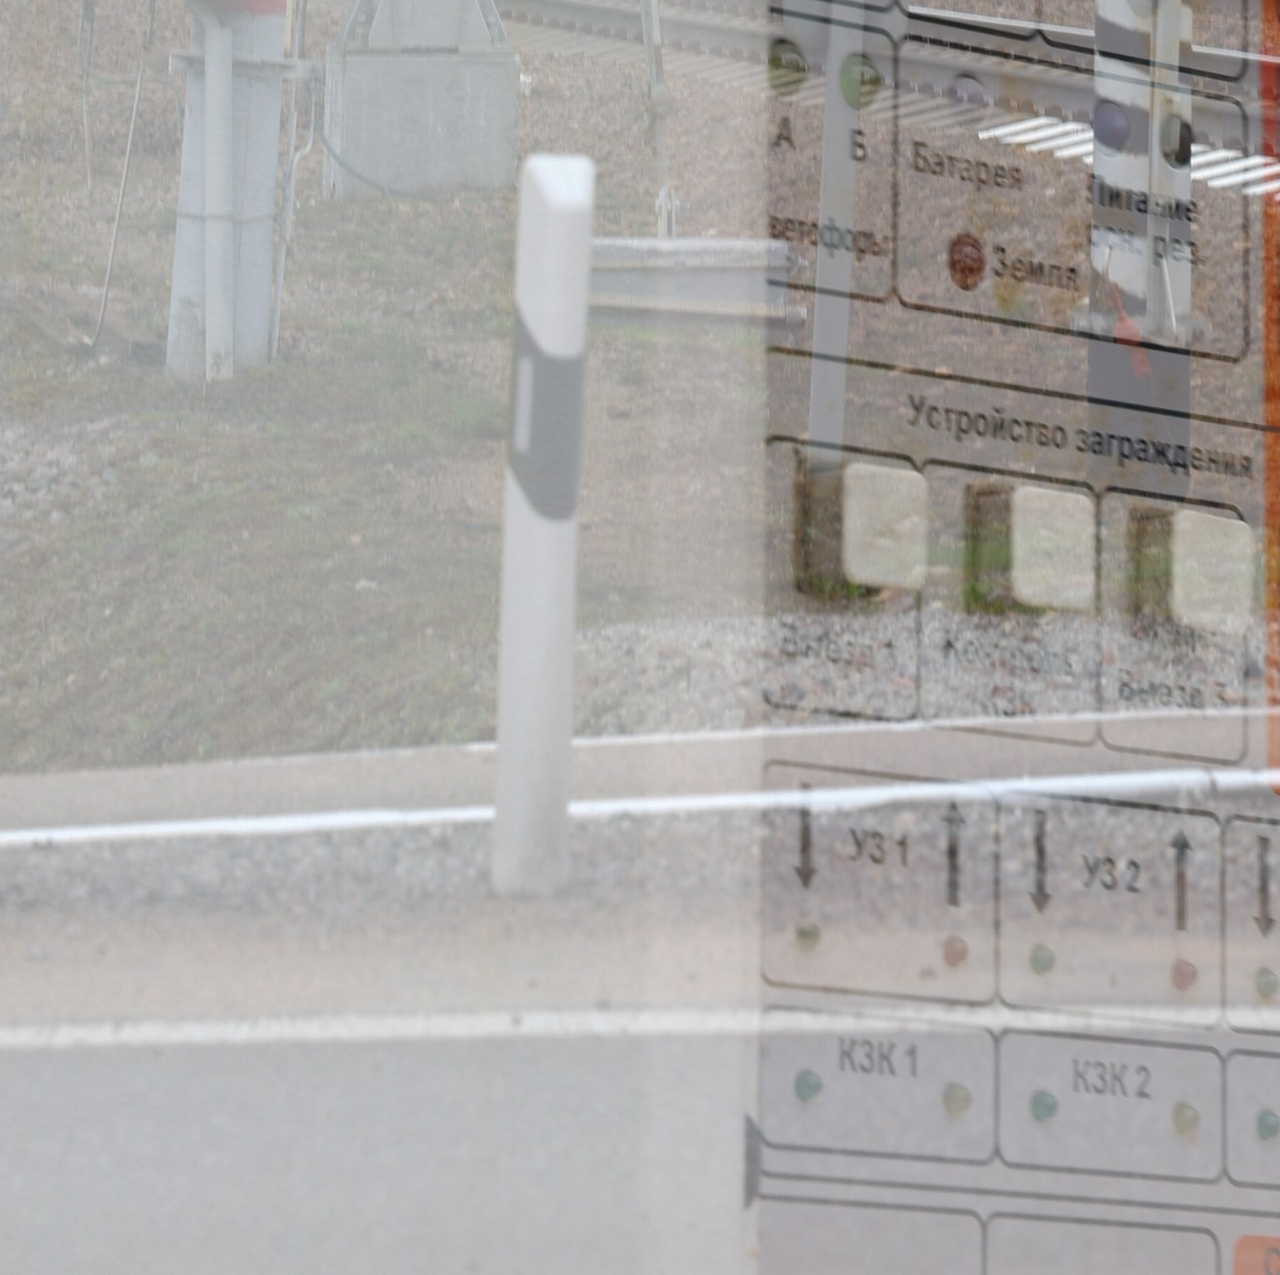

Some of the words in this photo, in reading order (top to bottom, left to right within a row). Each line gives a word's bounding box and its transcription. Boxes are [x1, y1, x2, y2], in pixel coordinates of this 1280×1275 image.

[773, 117, 795, 151] А
[850, 129, 867, 161] Б
[914, 141, 1022, 192] Батарея
[992, 244, 1080, 292] Земля
[908, 394, 1068, 452] Устройство
[1075, 427, 1254, 479] заграждения
[1126, 860, 1143, 893] 2
[906, 1044, 919, 1078] 1
[1137, 1066, 1153, 1100] 2
